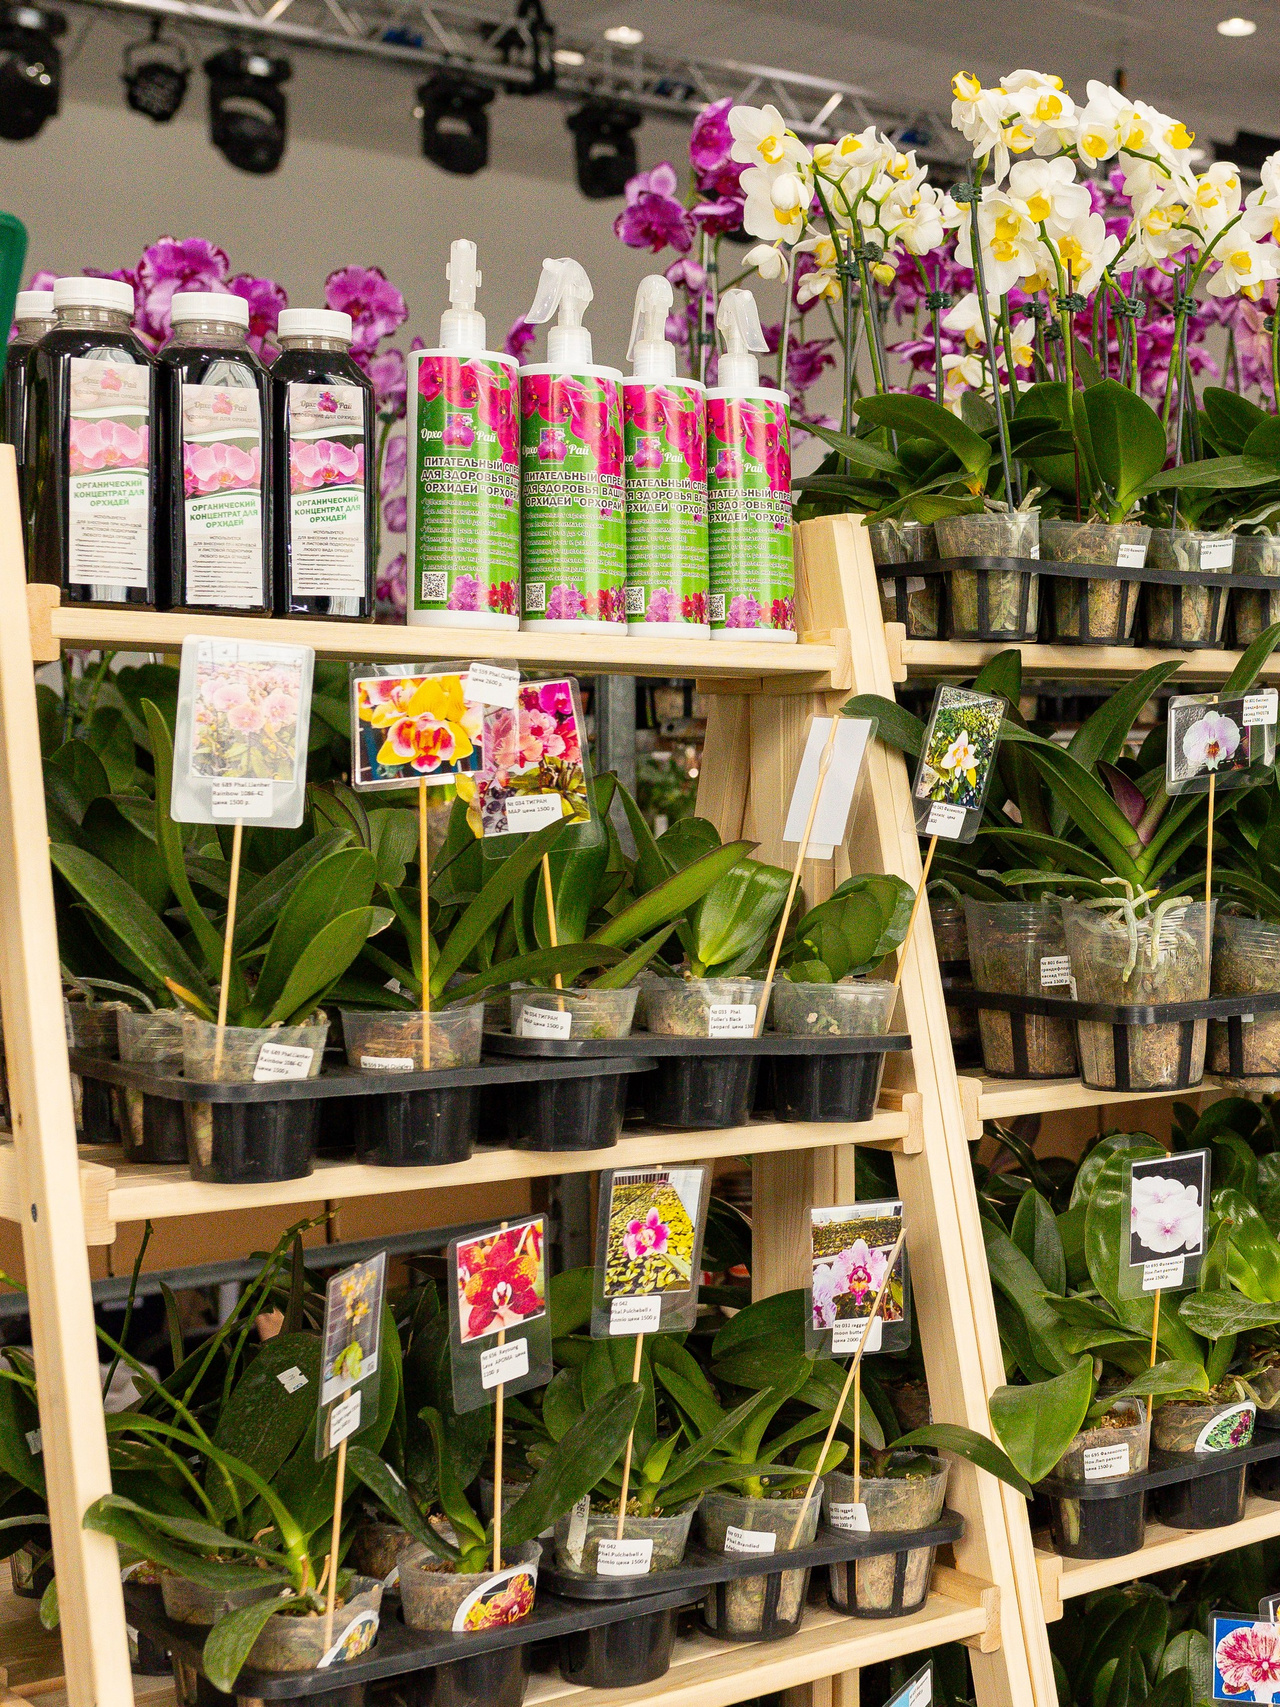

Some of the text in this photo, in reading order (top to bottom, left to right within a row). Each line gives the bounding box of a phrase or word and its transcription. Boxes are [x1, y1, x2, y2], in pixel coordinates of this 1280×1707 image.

[339, 402, 353, 410] Рай
[420, 427, 496, 443] Орхо Рай
[568, 444, 589, 456] Рай
[664, 452, 684, 463] Рай
[425, 457, 503, 471] ПИТАТЕЛЬНЫЙ
[744, 462, 763, 473] Рай
[421, 470, 441, 480] ДЛЯ
[443, 470, 504, 484] ЗДОРОВЬЯ
[524, 470, 598, 483] ПИТАТЕЛЬНЫЙ
[76, 479, 142, 489] ОРГАНИЧЕСКИЙ
[425, 482, 478, 494] ОРХИДЕЙ
[625, 477, 691, 489] ИТАТЕЛЬНЫЙ
[74, 489, 145, 498] КОНЦЕНТРАТ ДЛЯ
[539, 484, 599, 495] ЗДОРОВЬЯ
[708, 487, 771, 499] ИТАТЕЛЬНЫЙ
[90, 497, 129, 507] ОРХИДЕЙ
[297, 494, 359, 507] ОРГАНИЧЕСКИЙ
[525, 495, 572, 507] ОРХИДЕЙ
[636, 491, 692, 502] ЗДОРОВЬЯ
[192, 499, 256, 512] ОРГАНИЧЕСКИЙ
[294, 505, 344, 516] КОНЦЕНТРАТ
[626, 501, 669, 513] РХИДЕЙ
[718, 501, 773, 511] ЗДОРОВЬЯ
[190, 510, 241, 521] КОНЦЕНТРАТ
[309, 513, 347, 523] ОРХИДЕЙ
[709, 511, 748, 523] РХИДЕЙ
[205, 519, 244, 528] ОРХИДЕЙ
[538, 1013, 559, 1021] ТИГРАН
